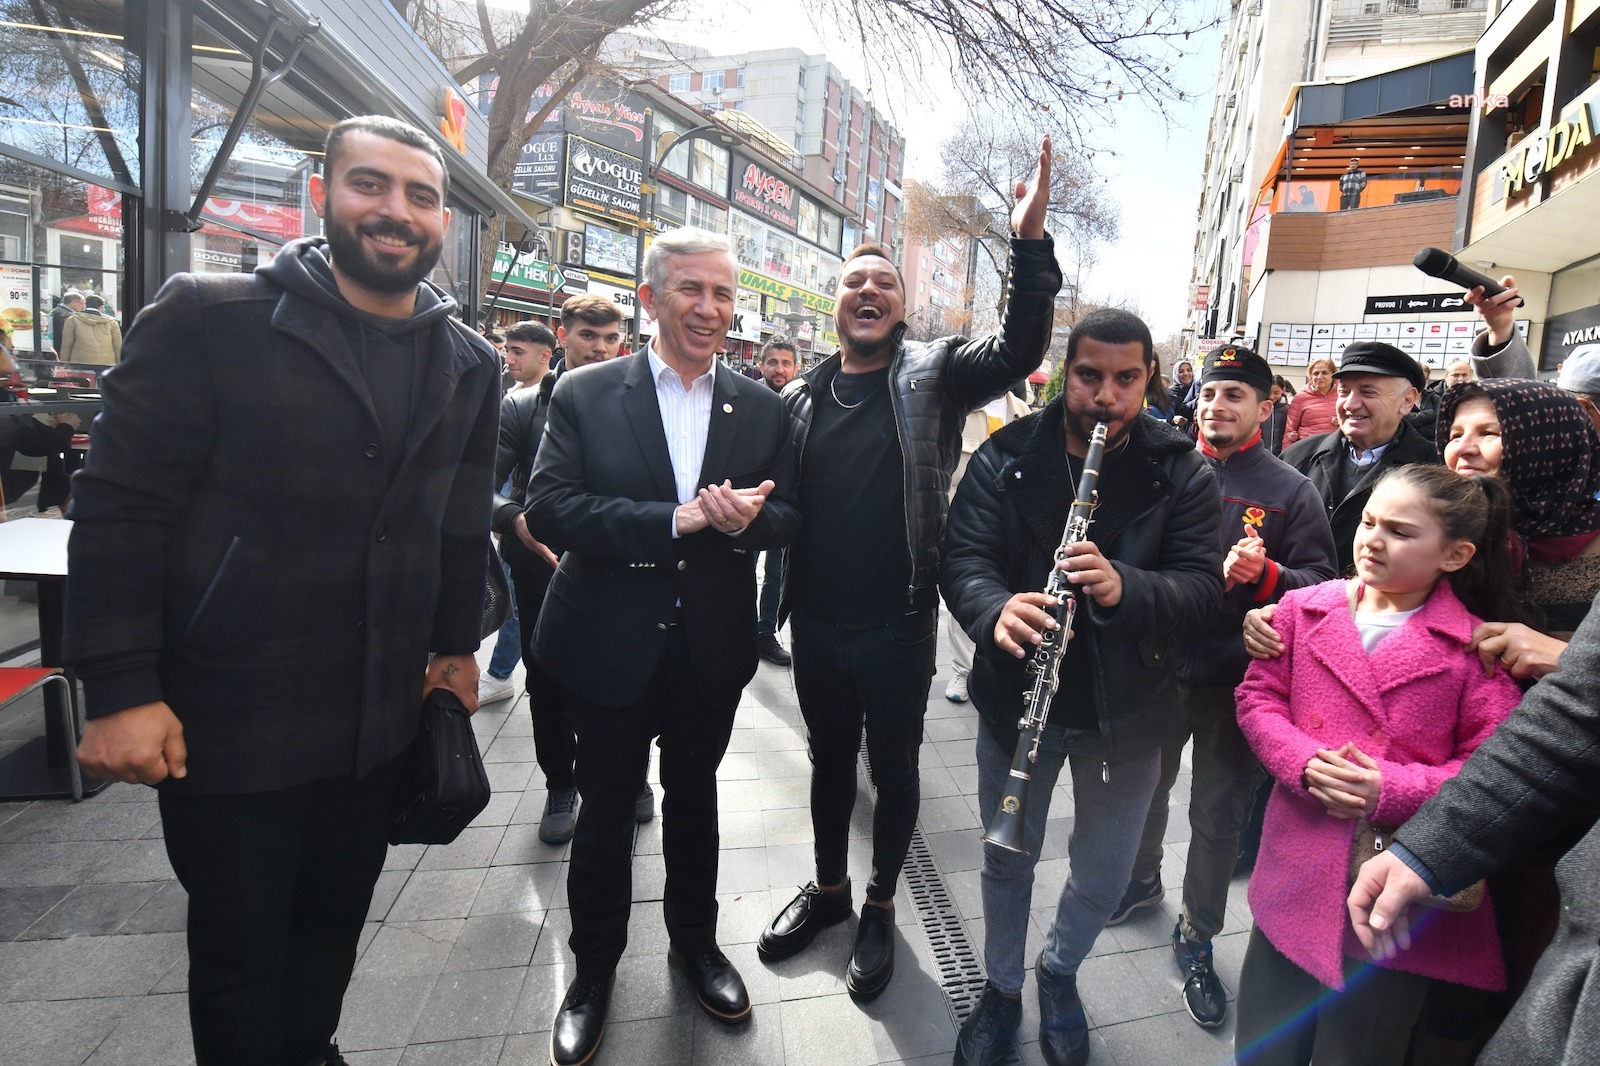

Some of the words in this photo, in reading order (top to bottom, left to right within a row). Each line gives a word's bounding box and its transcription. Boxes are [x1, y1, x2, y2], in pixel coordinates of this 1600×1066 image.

[522, 142, 559, 155] OGUE
[538, 153, 555, 162] LUX
[1504, 103, 1592, 201] MODA
[514, 165, 533, 173] ZELLİK
[583, 157, 643, 185] VOGUE
[570, 184, 610, 203] GÜZELLİK
[616, 179, 641, 195] LUX
[743, 163, 795, 210] AYŞEN
[98, 224, 122, 233] PASA
[492, 259, 520, 277] MAN
[524, 266, 559, 286] HEKM
[738, 271, 787, 299] UMAŞ
